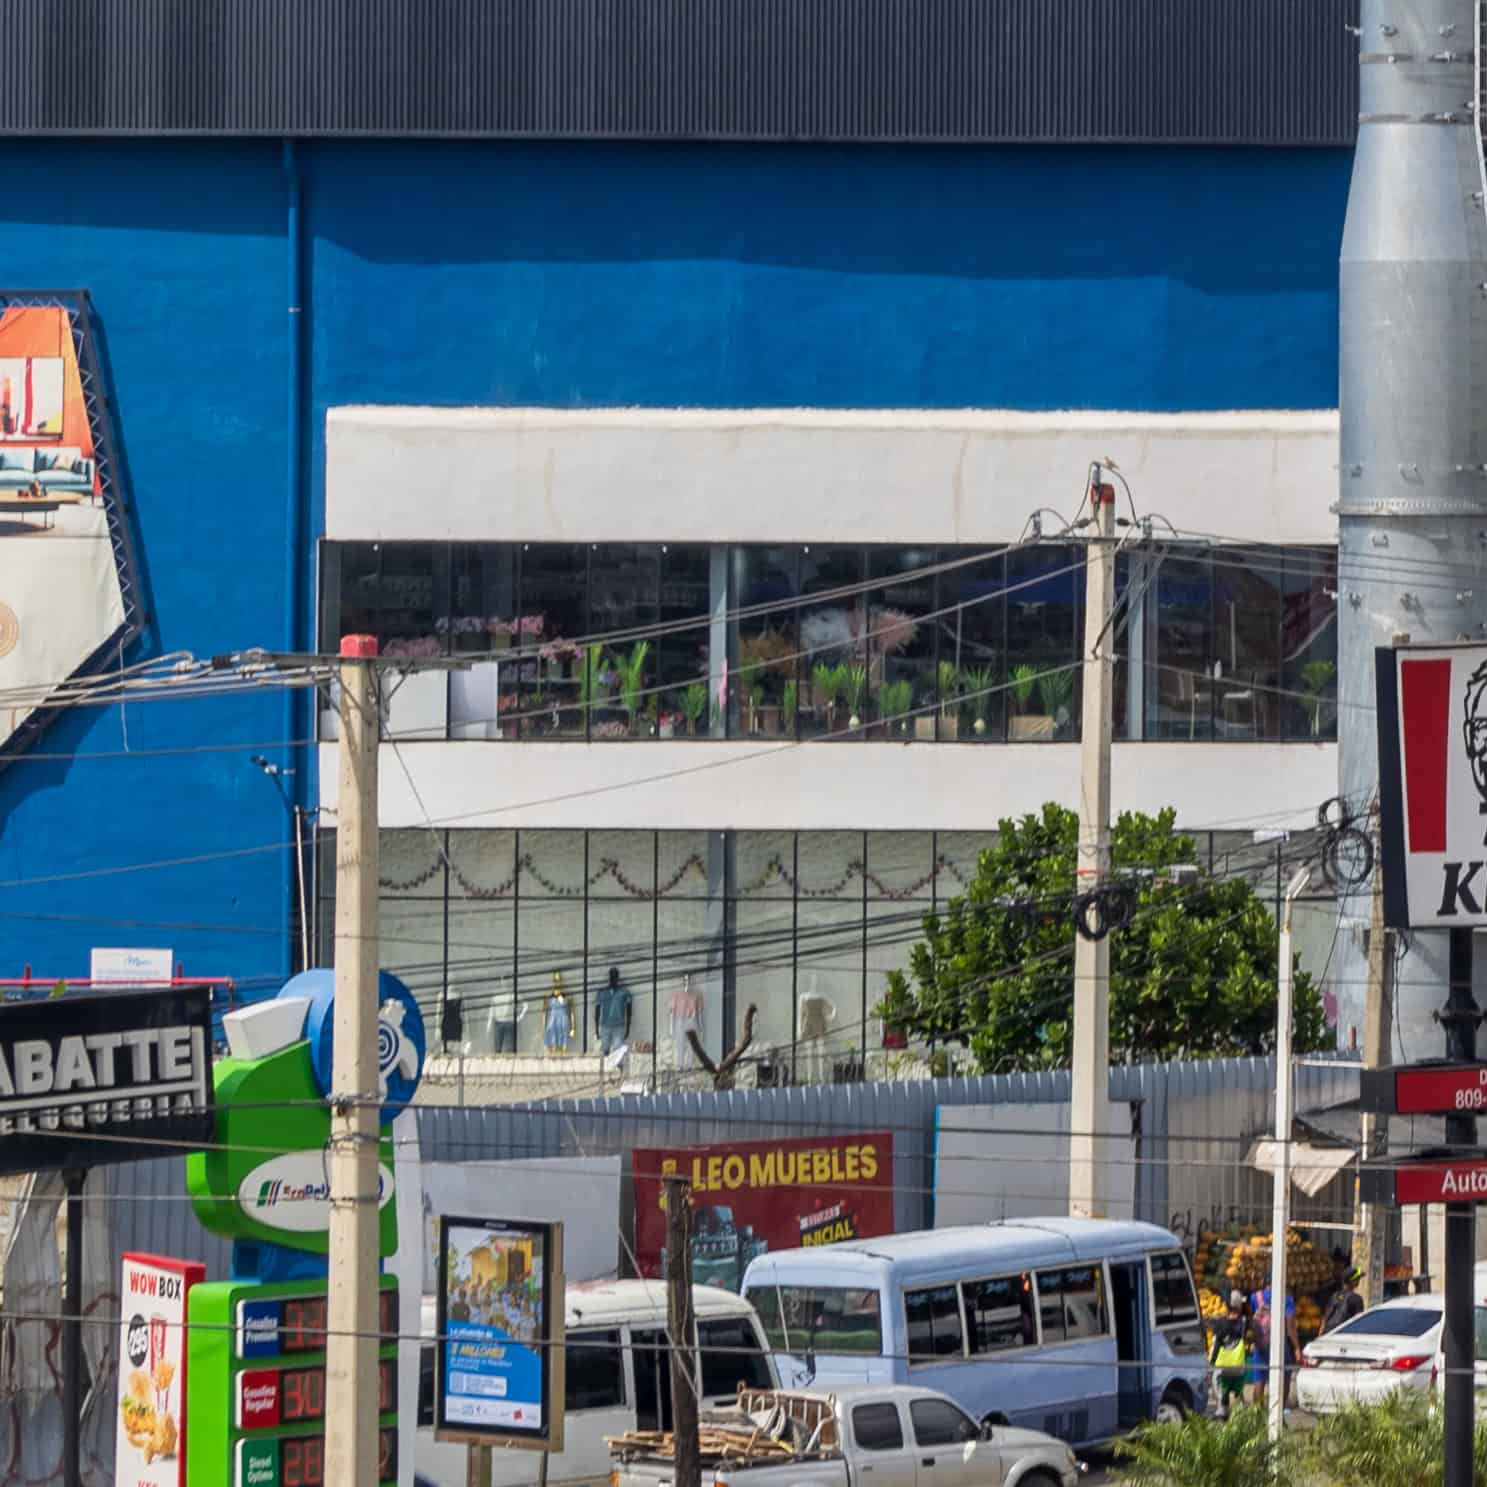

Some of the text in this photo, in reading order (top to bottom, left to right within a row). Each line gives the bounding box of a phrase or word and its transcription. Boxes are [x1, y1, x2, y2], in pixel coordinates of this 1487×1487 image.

[692, 1144, 879, 1192] LEO MUEBLES
[129, 1271, 182, 1302] WOW BOX
